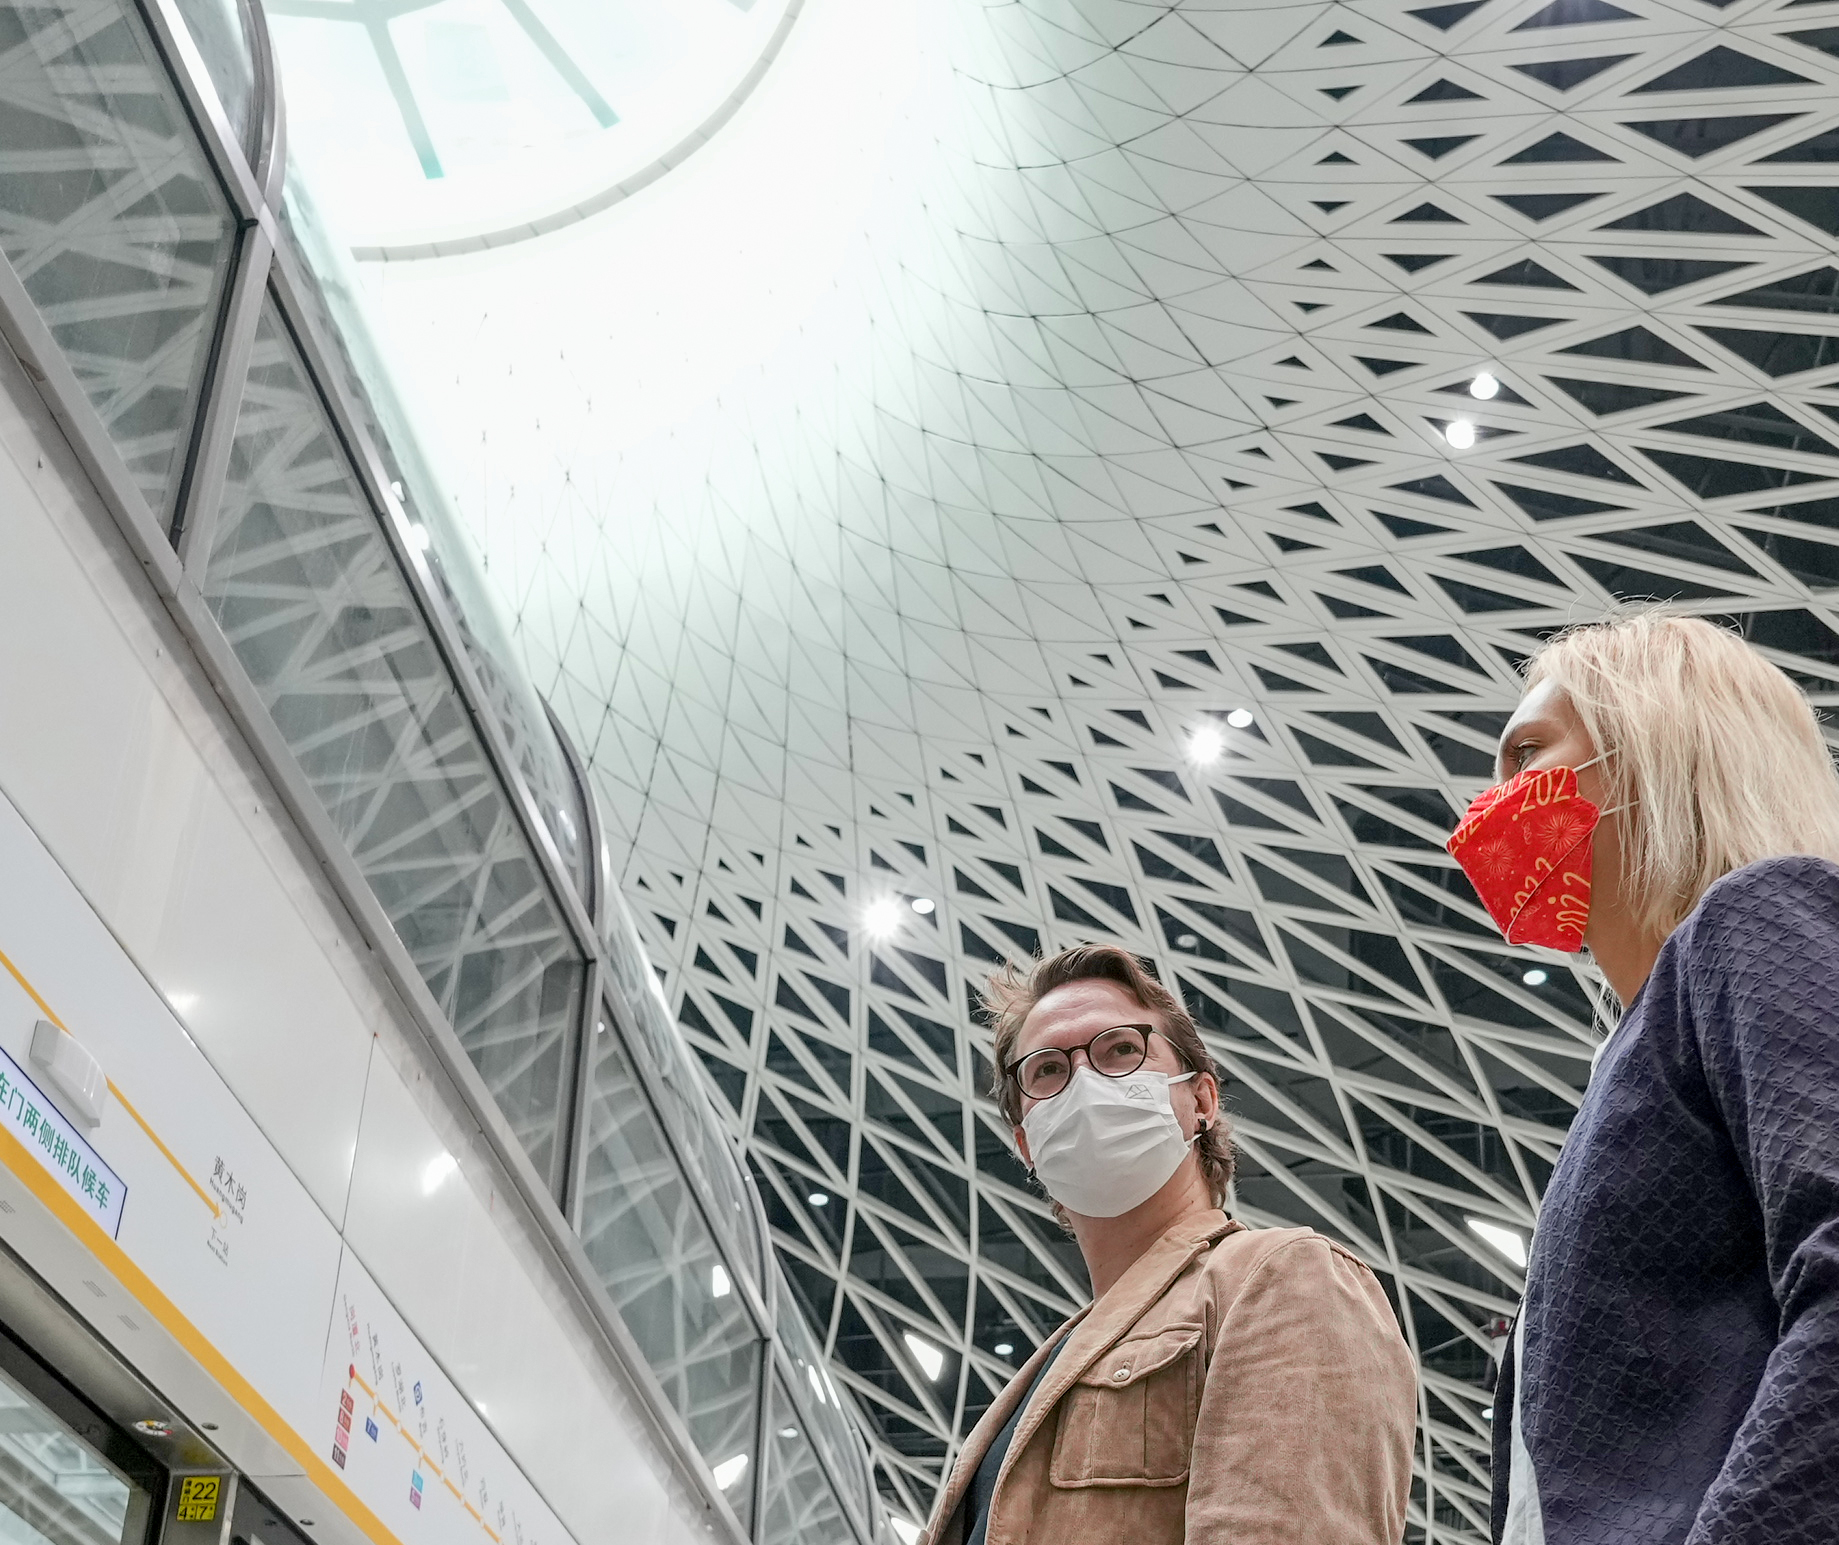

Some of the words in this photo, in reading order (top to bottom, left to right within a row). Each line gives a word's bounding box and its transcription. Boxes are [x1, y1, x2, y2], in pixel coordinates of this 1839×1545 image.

[213, 1155, 247, 1211] 黄木岗
[192, 1481, 216, 1500] 22
